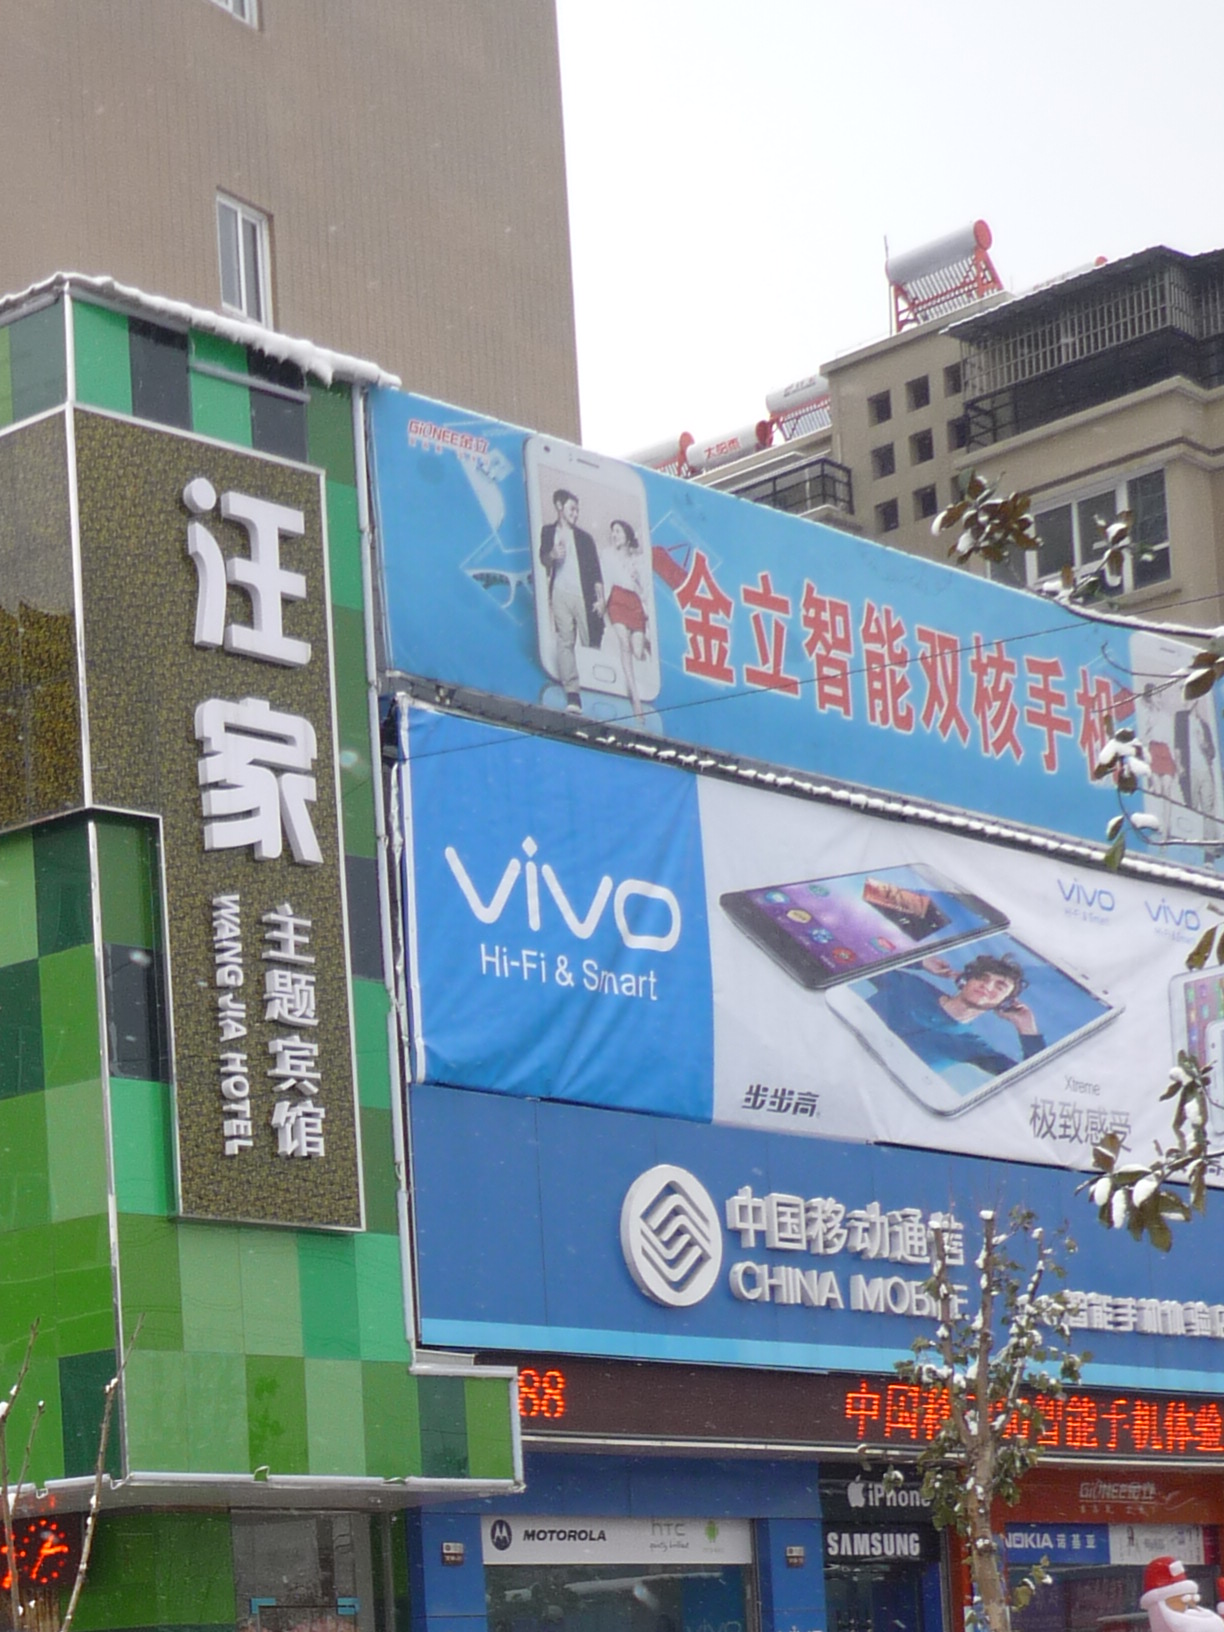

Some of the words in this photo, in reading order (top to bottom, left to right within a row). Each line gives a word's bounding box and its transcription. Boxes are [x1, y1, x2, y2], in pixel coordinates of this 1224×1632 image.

[181, 476, 324, 866] 汪家
[675, 550, 1122, 788] 金立智能双核手机
[444, 835, 682, 952] vivo
[1057, 877, 1116, 912] vivo
[1144, 898, 1201, 932] vivo
[212, 894, 245, 988] WANG
[480, 943, 547, 984] Hi-Fi
[555, 955, 575, 988] &
[582, 959, 658, 1001] Smart
[218, 993, 248, 1042] JIA
[261, 902, 326, 1158] 主题宾馆
[219, 1052, 254, 1157] HOTEL
[741, 1084, 819, 1118] 步步高
[729, 1259, 845, 1310] CHINA
[523, 1529, 607, 1542] MOTOROLA
[827, 1531, 921, 1556] SAMSUNG
